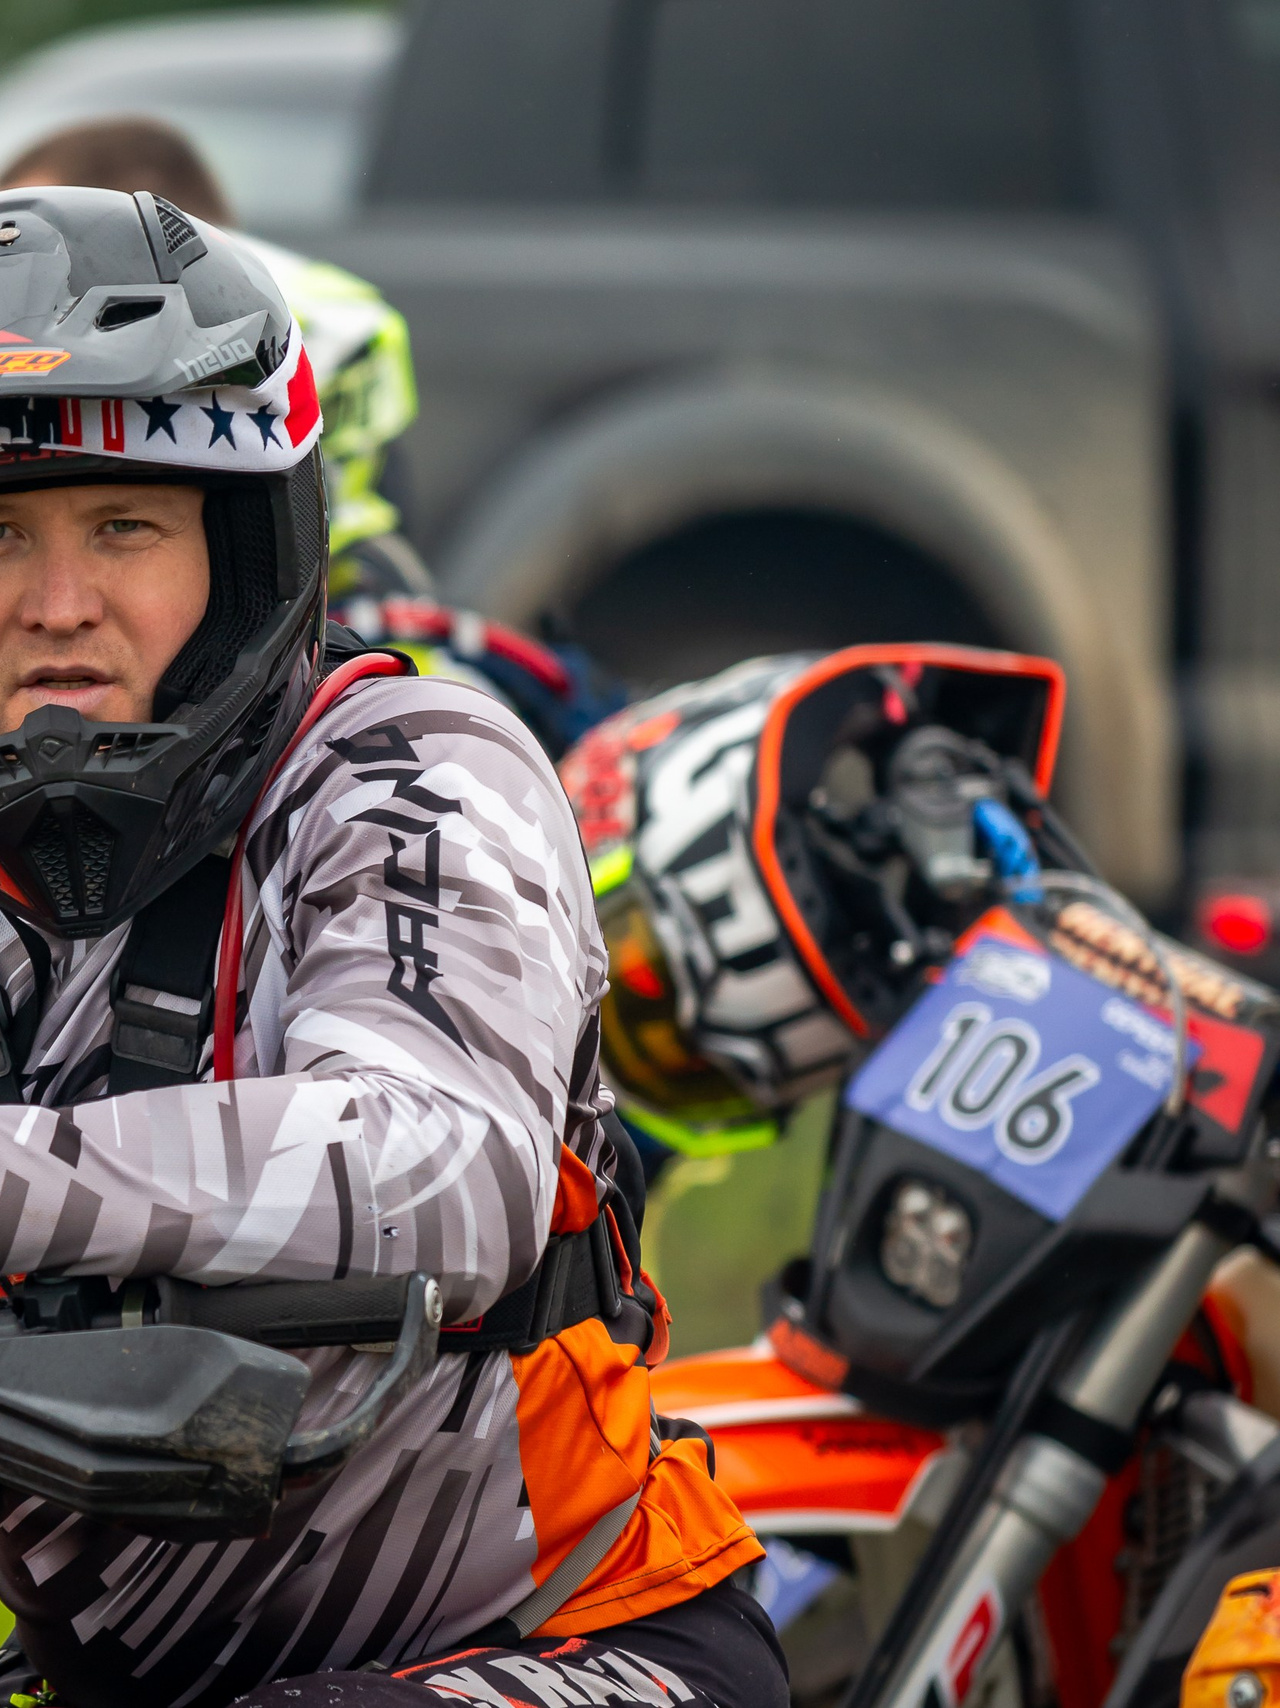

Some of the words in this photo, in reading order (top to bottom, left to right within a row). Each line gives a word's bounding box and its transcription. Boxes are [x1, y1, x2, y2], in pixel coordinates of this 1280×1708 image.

[173, 338, 256, 382] hebo
[324, 724, 478, 1066] RACING
[906, 1001, 1101, 1166] 106
